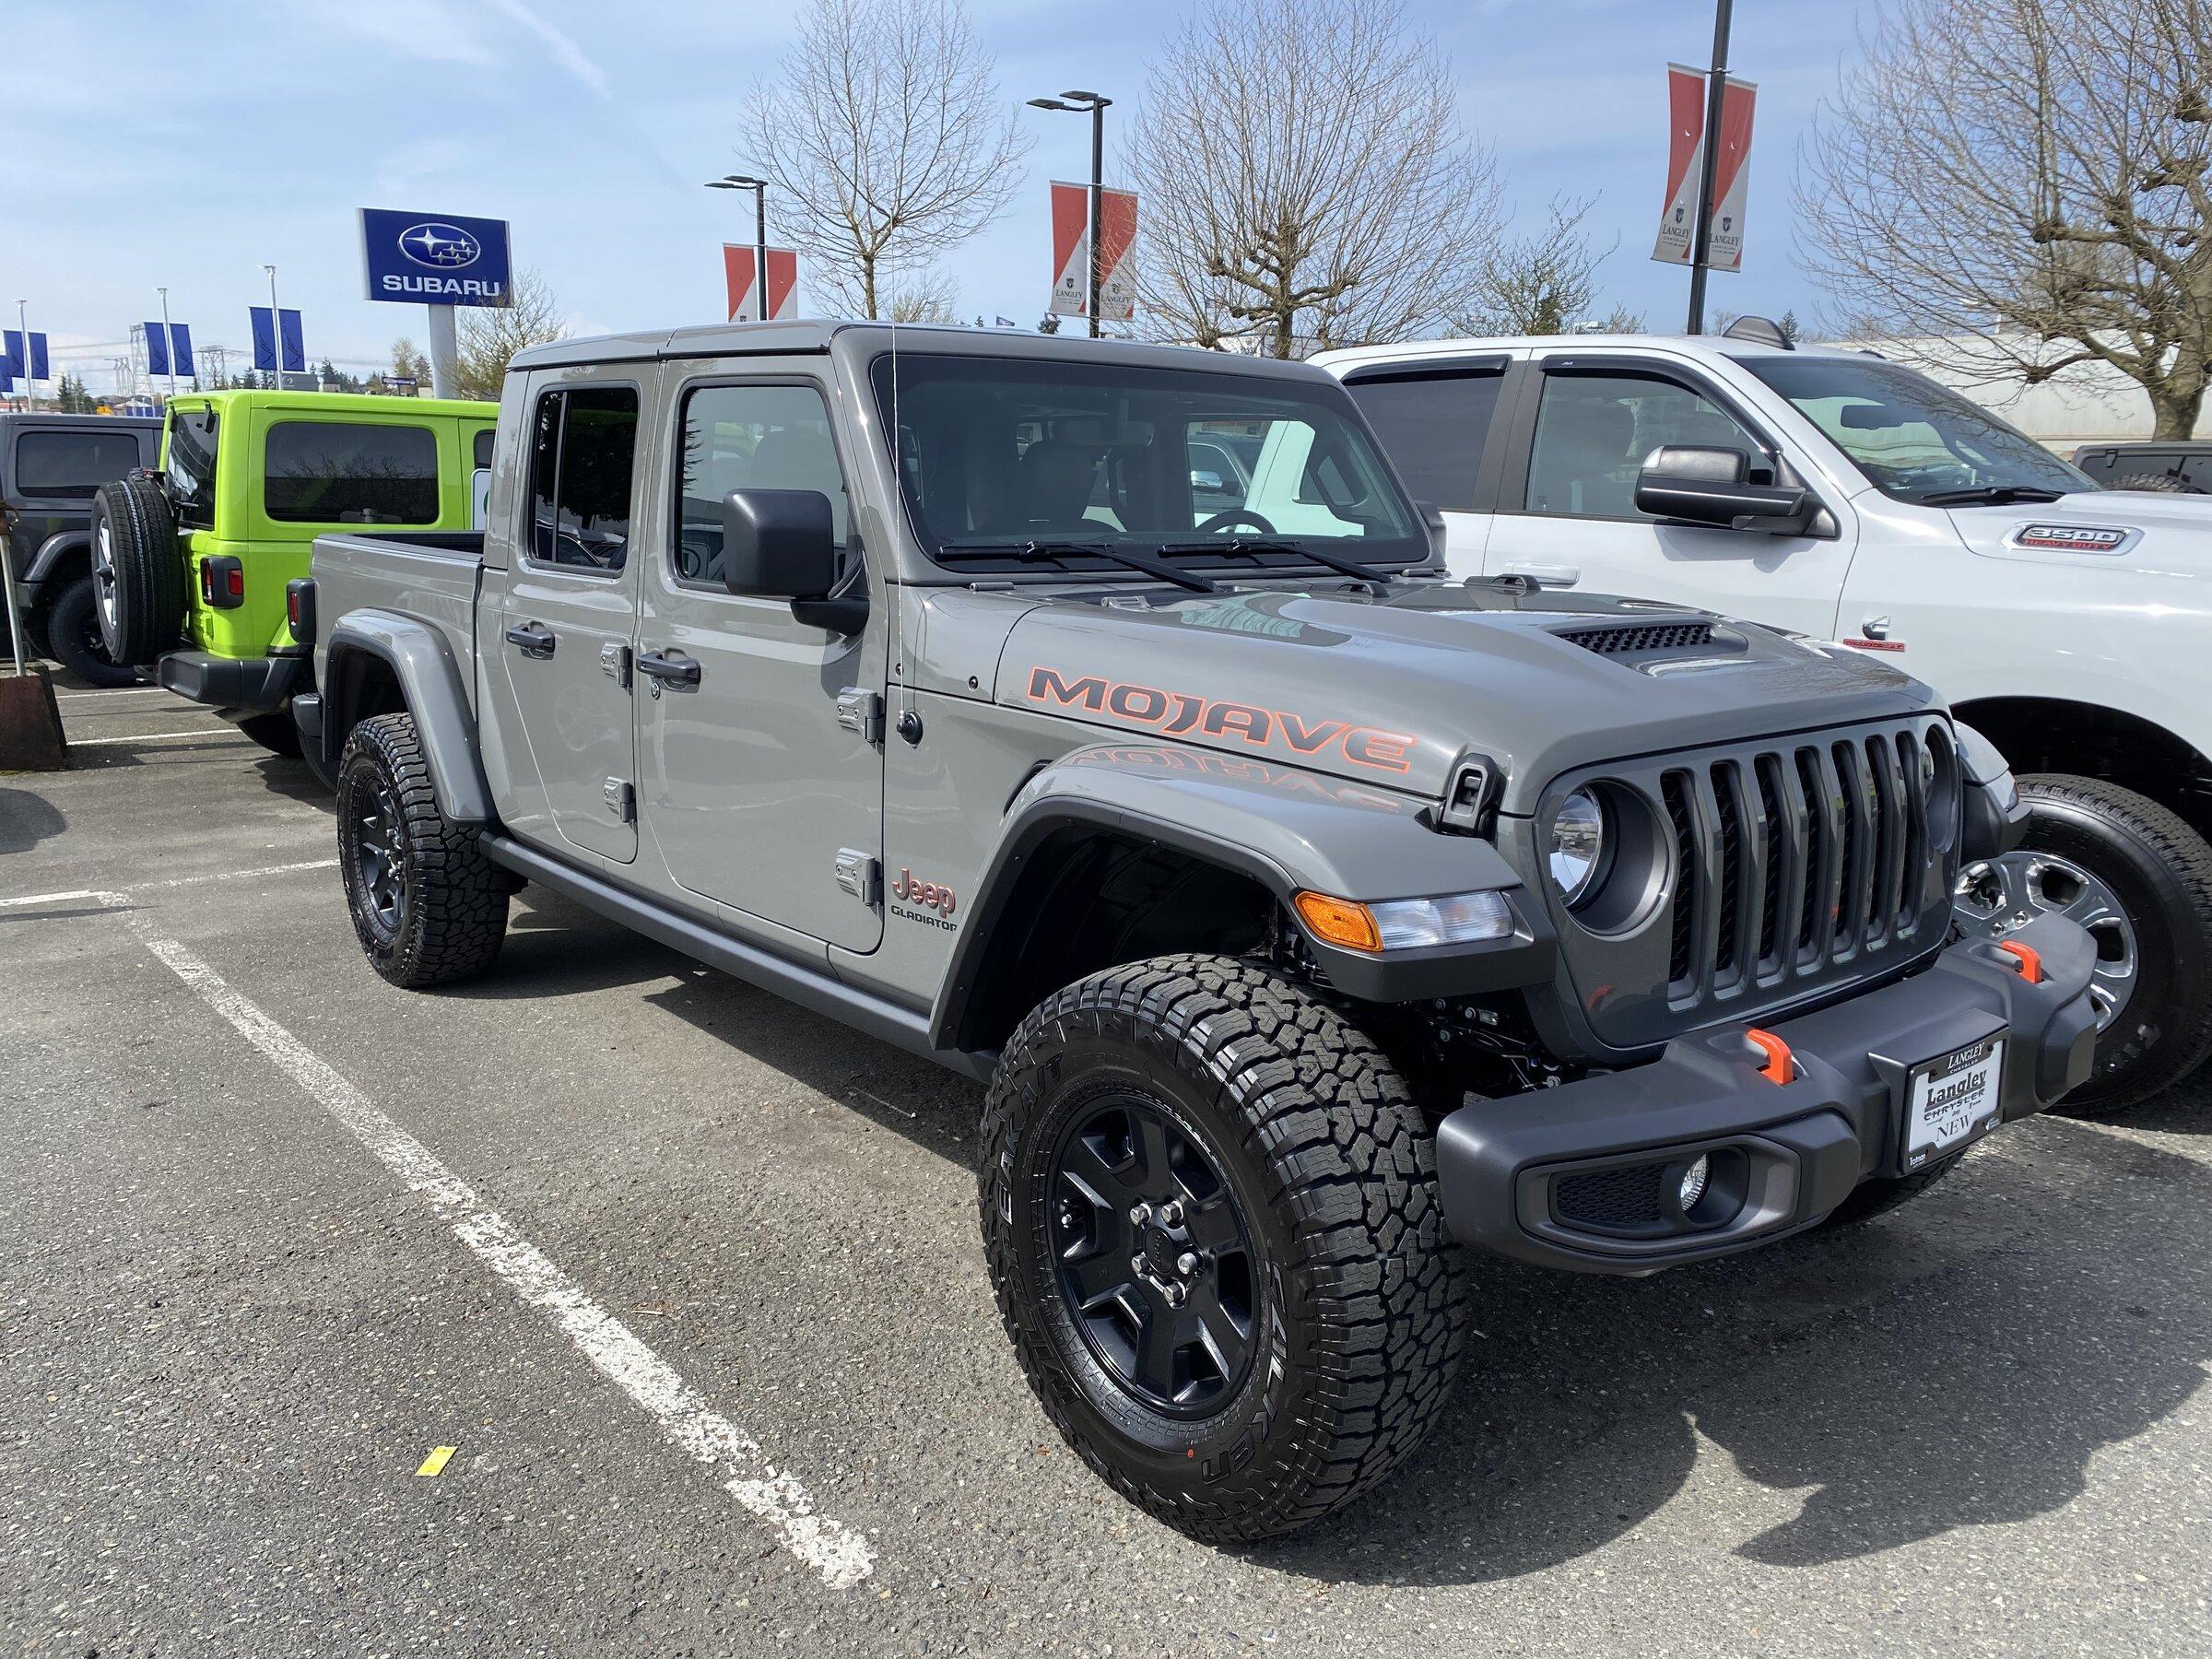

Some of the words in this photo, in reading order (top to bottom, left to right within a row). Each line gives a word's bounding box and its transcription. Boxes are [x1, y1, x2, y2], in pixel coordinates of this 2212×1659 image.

[1663, 224, 1689, 239] LANGLEY
[382, 275, 500, 297] SUBARU
[1055, 289, 1082, 299] LANGLEY
[2024, 539, 2070, 547] HEAVY
[2073, 542, 2111, 550] DUTY
[2029, 529, 2118, 542] 3500
[1028, 666, 1416, 774] MOJAVE
[892, 867, 956, 919] Jeep
[890, 904, 958, 932] GLADIATOR
[1947, 1042, 1985, 1069] LANGLEY
[1926, 1069, 1988, 1108] Langley
[1924, 1088, 1985, 1121] CHRYSLER
[1936, 1112, 1973, 1142] NEW
